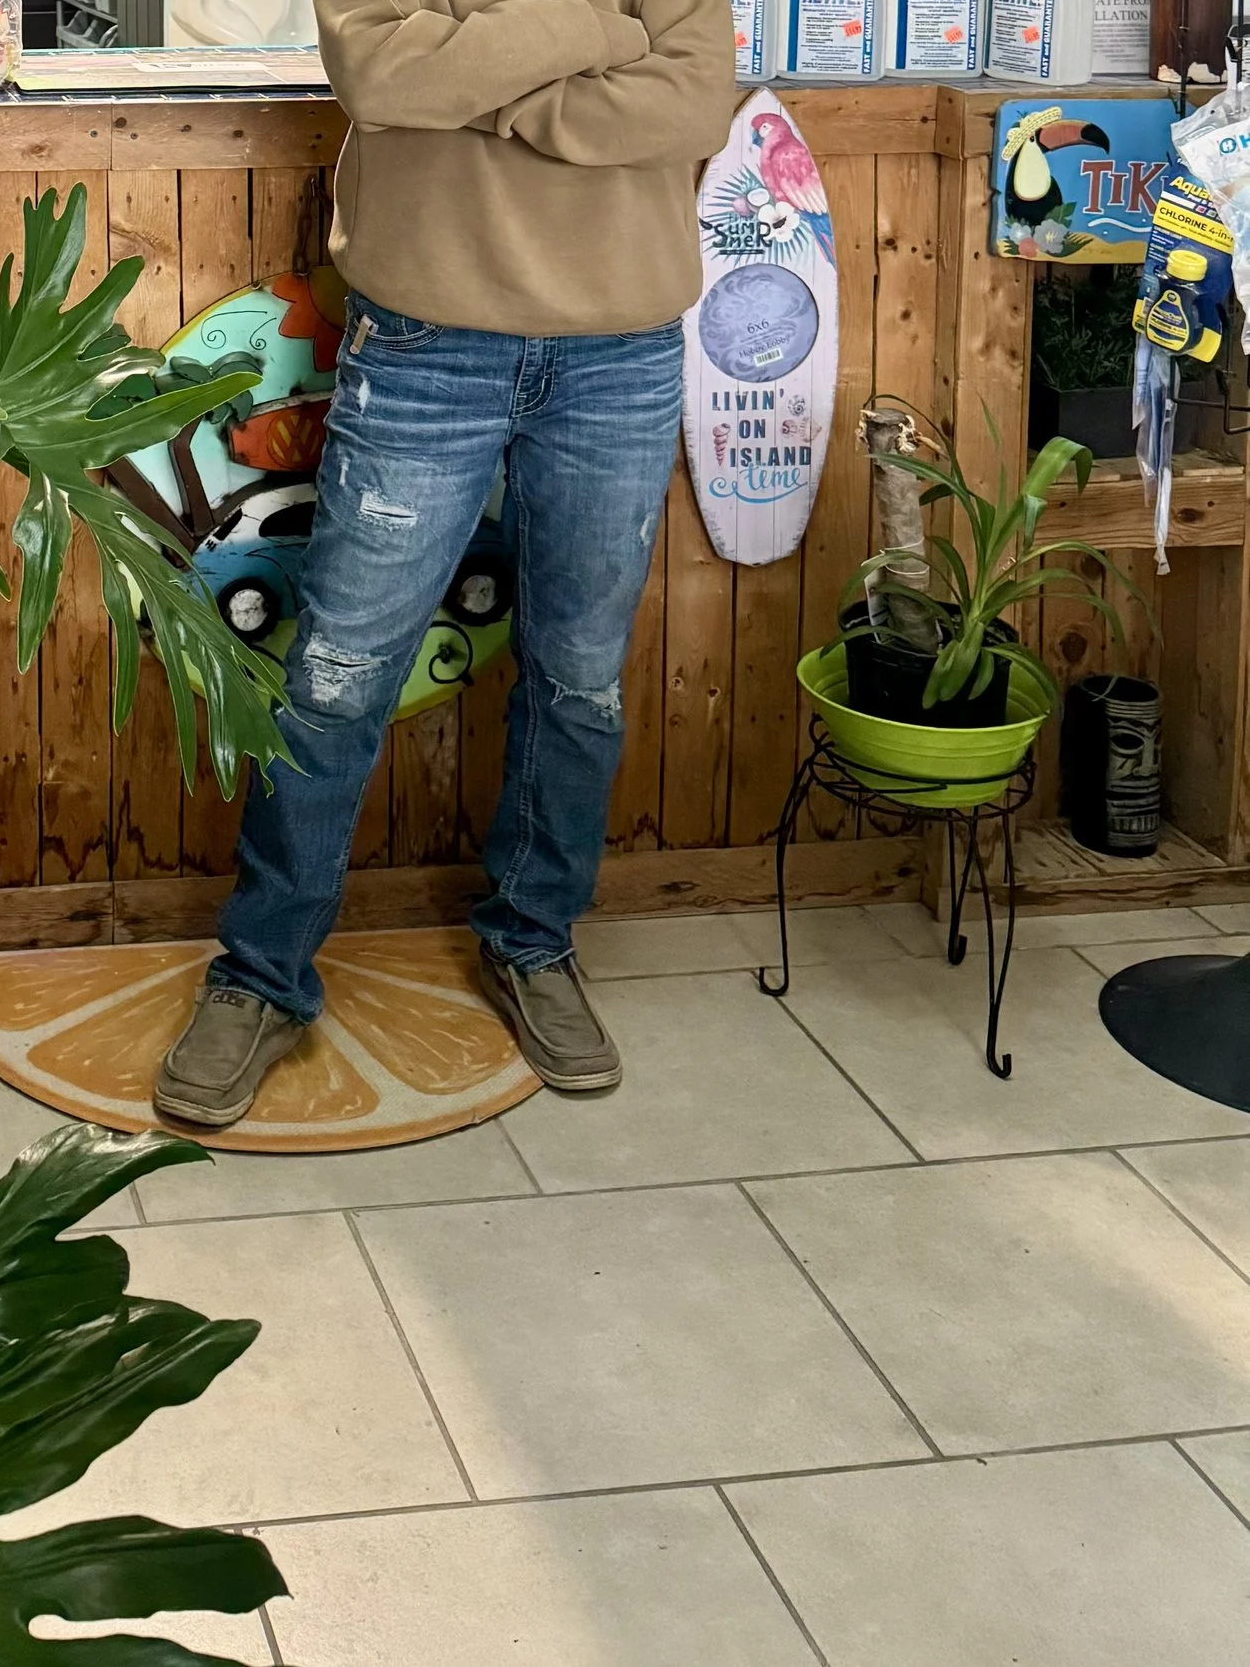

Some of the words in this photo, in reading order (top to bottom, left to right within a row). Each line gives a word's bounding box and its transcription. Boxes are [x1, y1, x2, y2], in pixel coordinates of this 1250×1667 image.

[1095, 10, 1148, 21] LLATION
[752, 53, 762, 73] FAST
[862, 53, 872, 73] FAST
[967, 50, 975, 69] FAST
[1041, 57, 1050, 77] FAST
[1080, 159, 1169, 216] TIK
[1169, 176, 1213, 202] Aqua
[1160, 207, 1208, 231] CHLORINE
[747, 318, 770, 334] 6x6
[738, 342, 766, 358] Hobby
[766, 335, 790, 351] Lobby
[739, 419, 766, 439] ON
[729, 446, 811, 468] ISLAND
